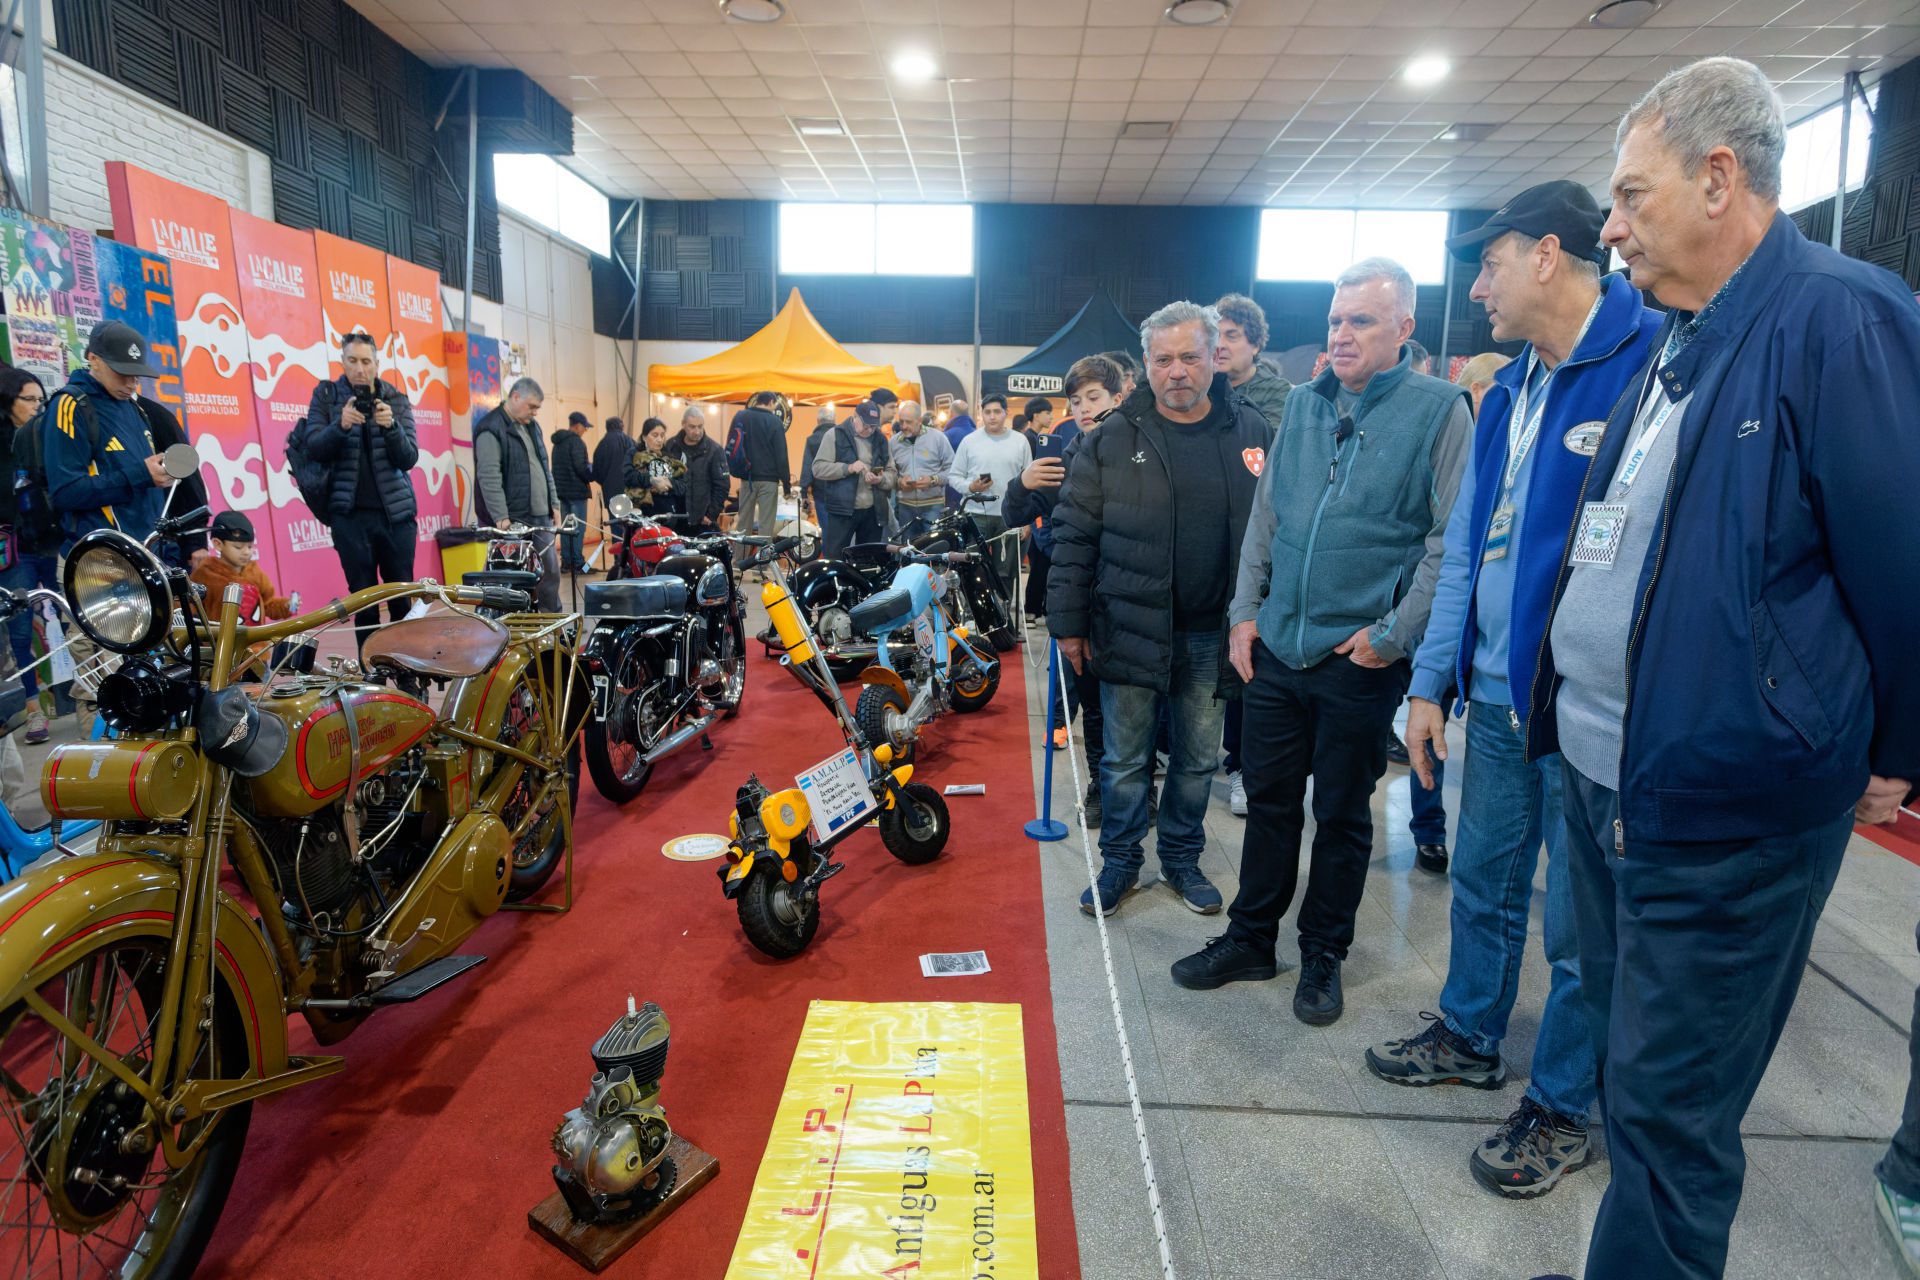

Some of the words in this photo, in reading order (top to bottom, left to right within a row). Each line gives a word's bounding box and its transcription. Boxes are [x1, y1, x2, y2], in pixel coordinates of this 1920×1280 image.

[151, 218, 169, 246] LA
[168, 221, 217, 256] CALLE
[248, 253, 264, 278] LA
[262, 256, 304, 287] CALLE
[141, 256, 171, 317] EL
[329, 270, 342, 291] LA
[340, 271, 375, 298] CALLE
[405, 291, 433, 314] CALLE
[151, 342, 184, 432] FU
[1010, 376, 1060, 391] CECCATO
[184, 392, 239, 406] ERAZATEGUI
[185, 404, 240, 416] UNICIPALIDAD
[270, 401, 310, 415] BERAZATE
[1517, 415, 1541, 457] AUTOCLUB
[594, 627, 614, 636] DKW
[841, 807, 856, 822] YPF
[903, 1046, 938, 1097] Plata
